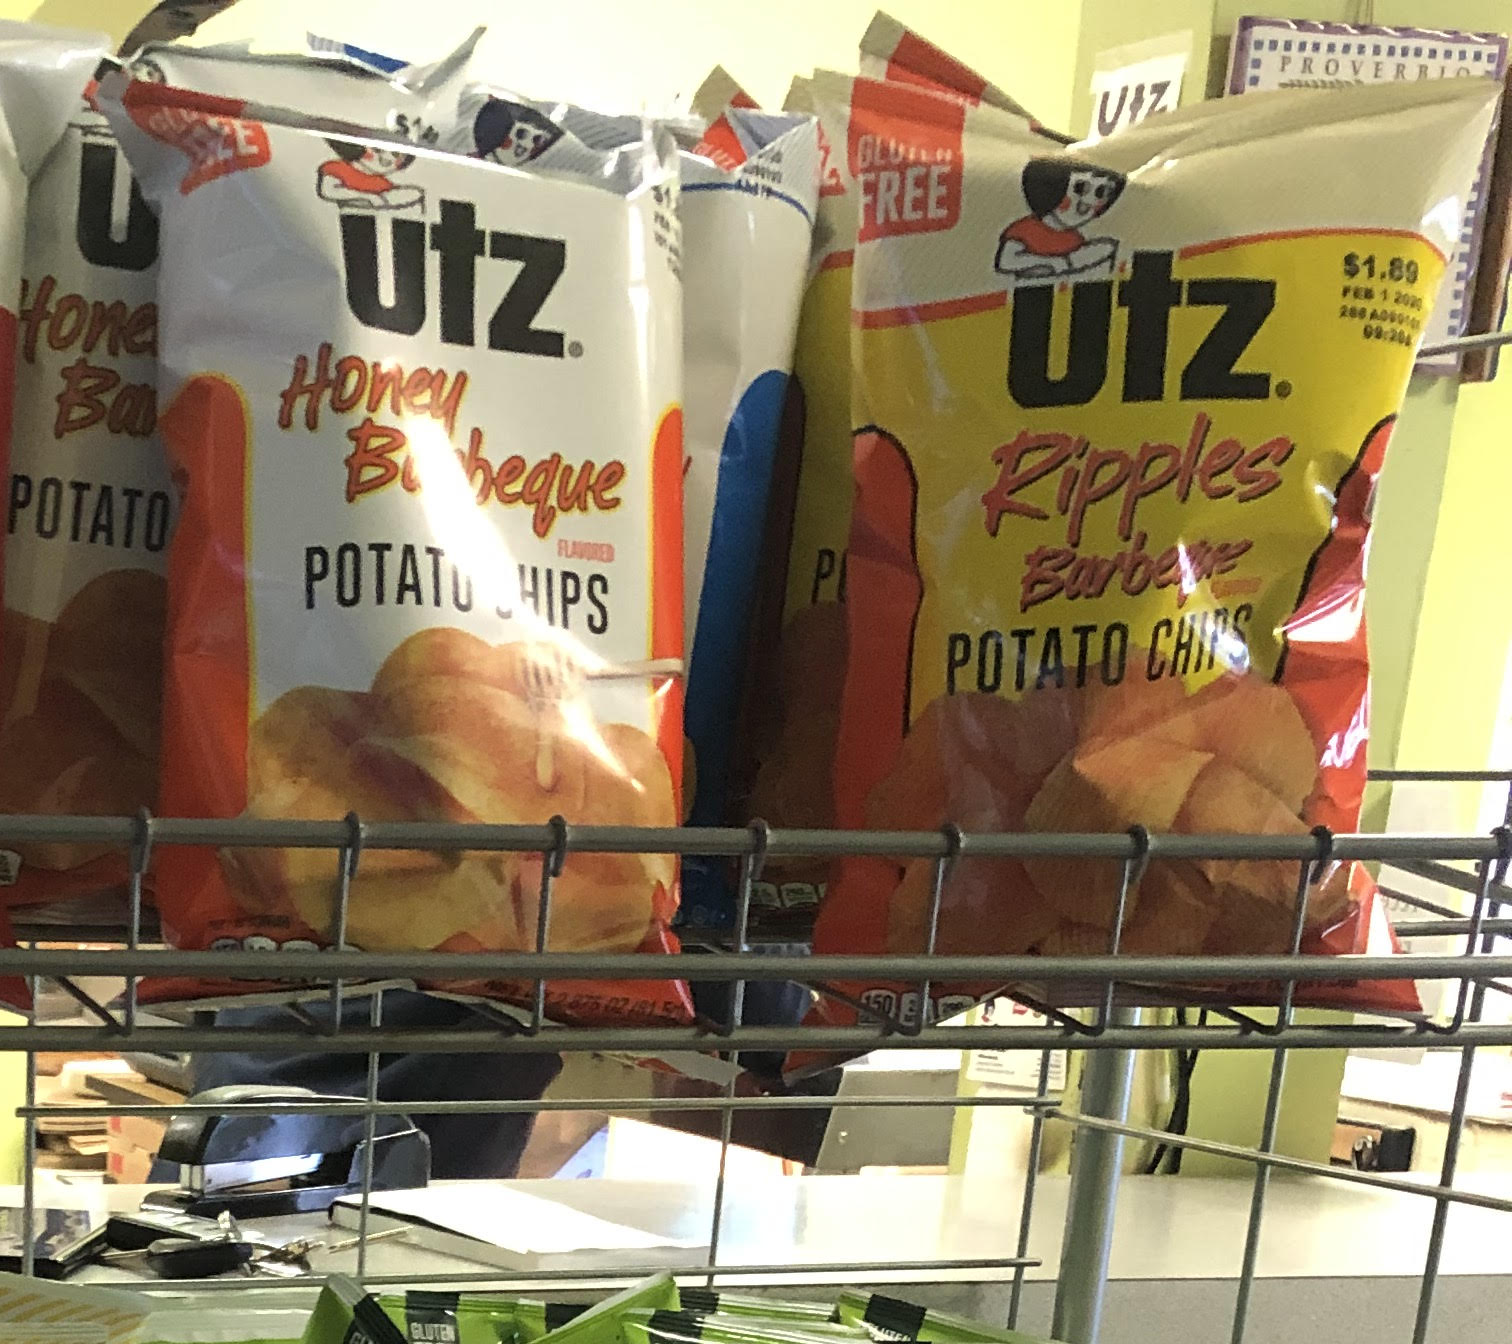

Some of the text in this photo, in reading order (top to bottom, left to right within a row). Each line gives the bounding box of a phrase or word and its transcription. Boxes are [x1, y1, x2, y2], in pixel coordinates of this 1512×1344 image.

[857, 165, 952, 226] FREE
[280, 342, 469, 432] Honey
[9, 474, 170, 552] POTATO
[981, 412, 1294, 547] Ripples
